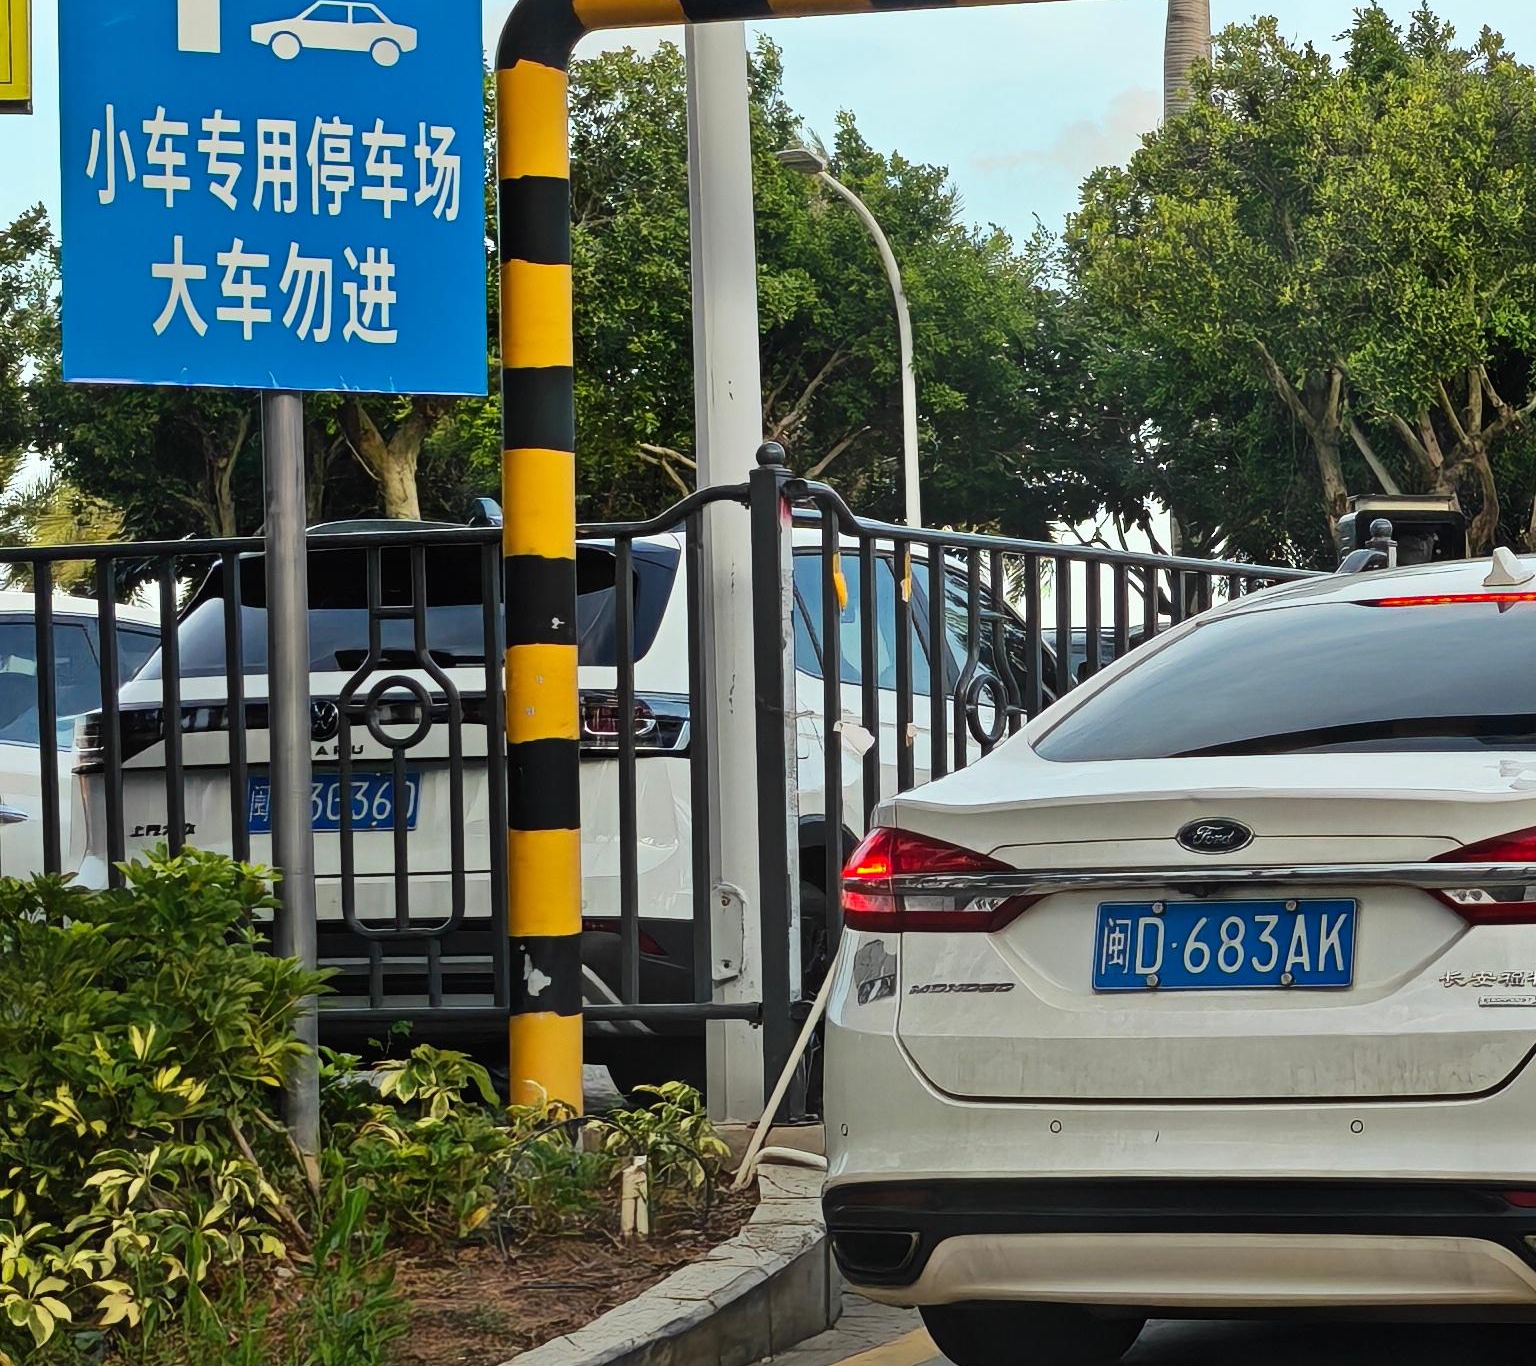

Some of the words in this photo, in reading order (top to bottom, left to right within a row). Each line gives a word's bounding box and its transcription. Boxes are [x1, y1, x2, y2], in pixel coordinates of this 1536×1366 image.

[85, 103, 462, 222] 小车专用停车场
[151, 235, 399, 344] 大车勿进
[1192, 824, 1236, 845] Ford
